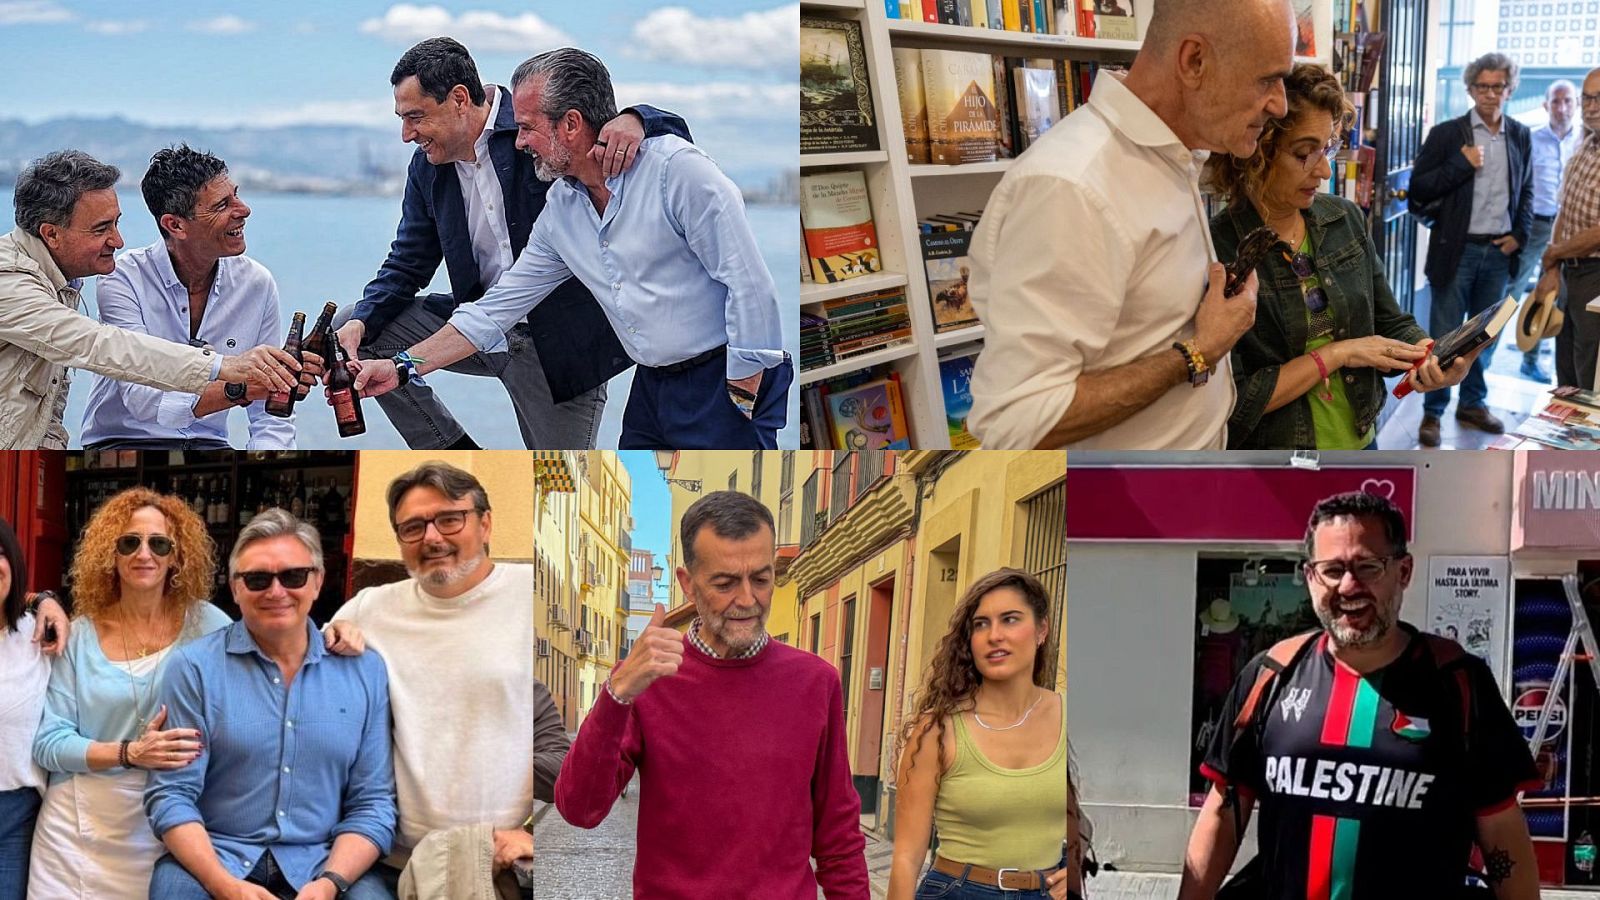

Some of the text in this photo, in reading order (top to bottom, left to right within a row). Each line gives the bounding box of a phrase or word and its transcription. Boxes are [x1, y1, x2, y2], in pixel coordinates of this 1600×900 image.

[964, 96, 986, 109] HIJO
[1533, 471, 1600, 509] MIN
[1447, 566, 1490, 576] PARA VIVIR
[1435, 577, 1458, 587] HASTA
[1460, 578, 1469, 587] LA
[1455, 589, 1480, 599] STORY.
[1514, 710, 1564, 721] PESI
[1266, 756, 1435, 808] PALESTINE
